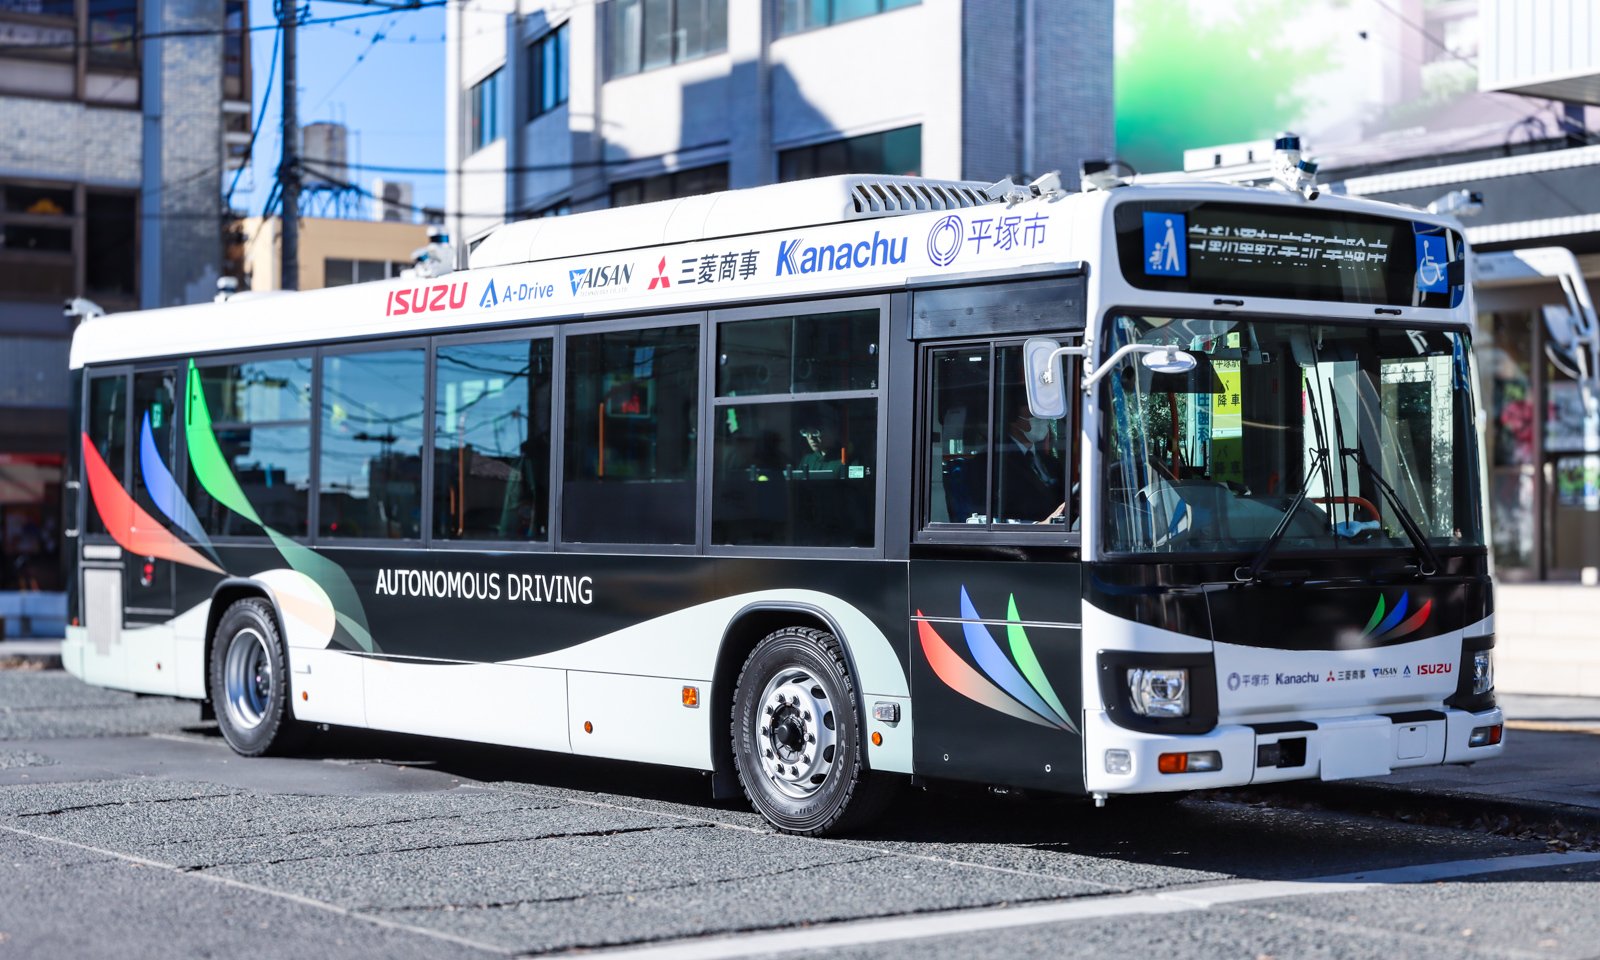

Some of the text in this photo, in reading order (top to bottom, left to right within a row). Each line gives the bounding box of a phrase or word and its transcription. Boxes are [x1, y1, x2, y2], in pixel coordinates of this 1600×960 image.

[967, 212, 1049, 254] 平塚市
[677, 249, 760, 285] 三菱商事
[775, 230, 908, 277] Kanachu
[386, 282, 468, 316] ISUZU
[502, 282, 554, 303] A-Drive
[375, 568, 593, 605] AUTONOMOUS DRIVING
[1241, 674, 1269, 687] 平塚市
[1275, 671, 1319, 685] Kanachu
[1337, 669, 1366, 681] 三菱商事
[1417, 663, 1452, 676] ISUZU
